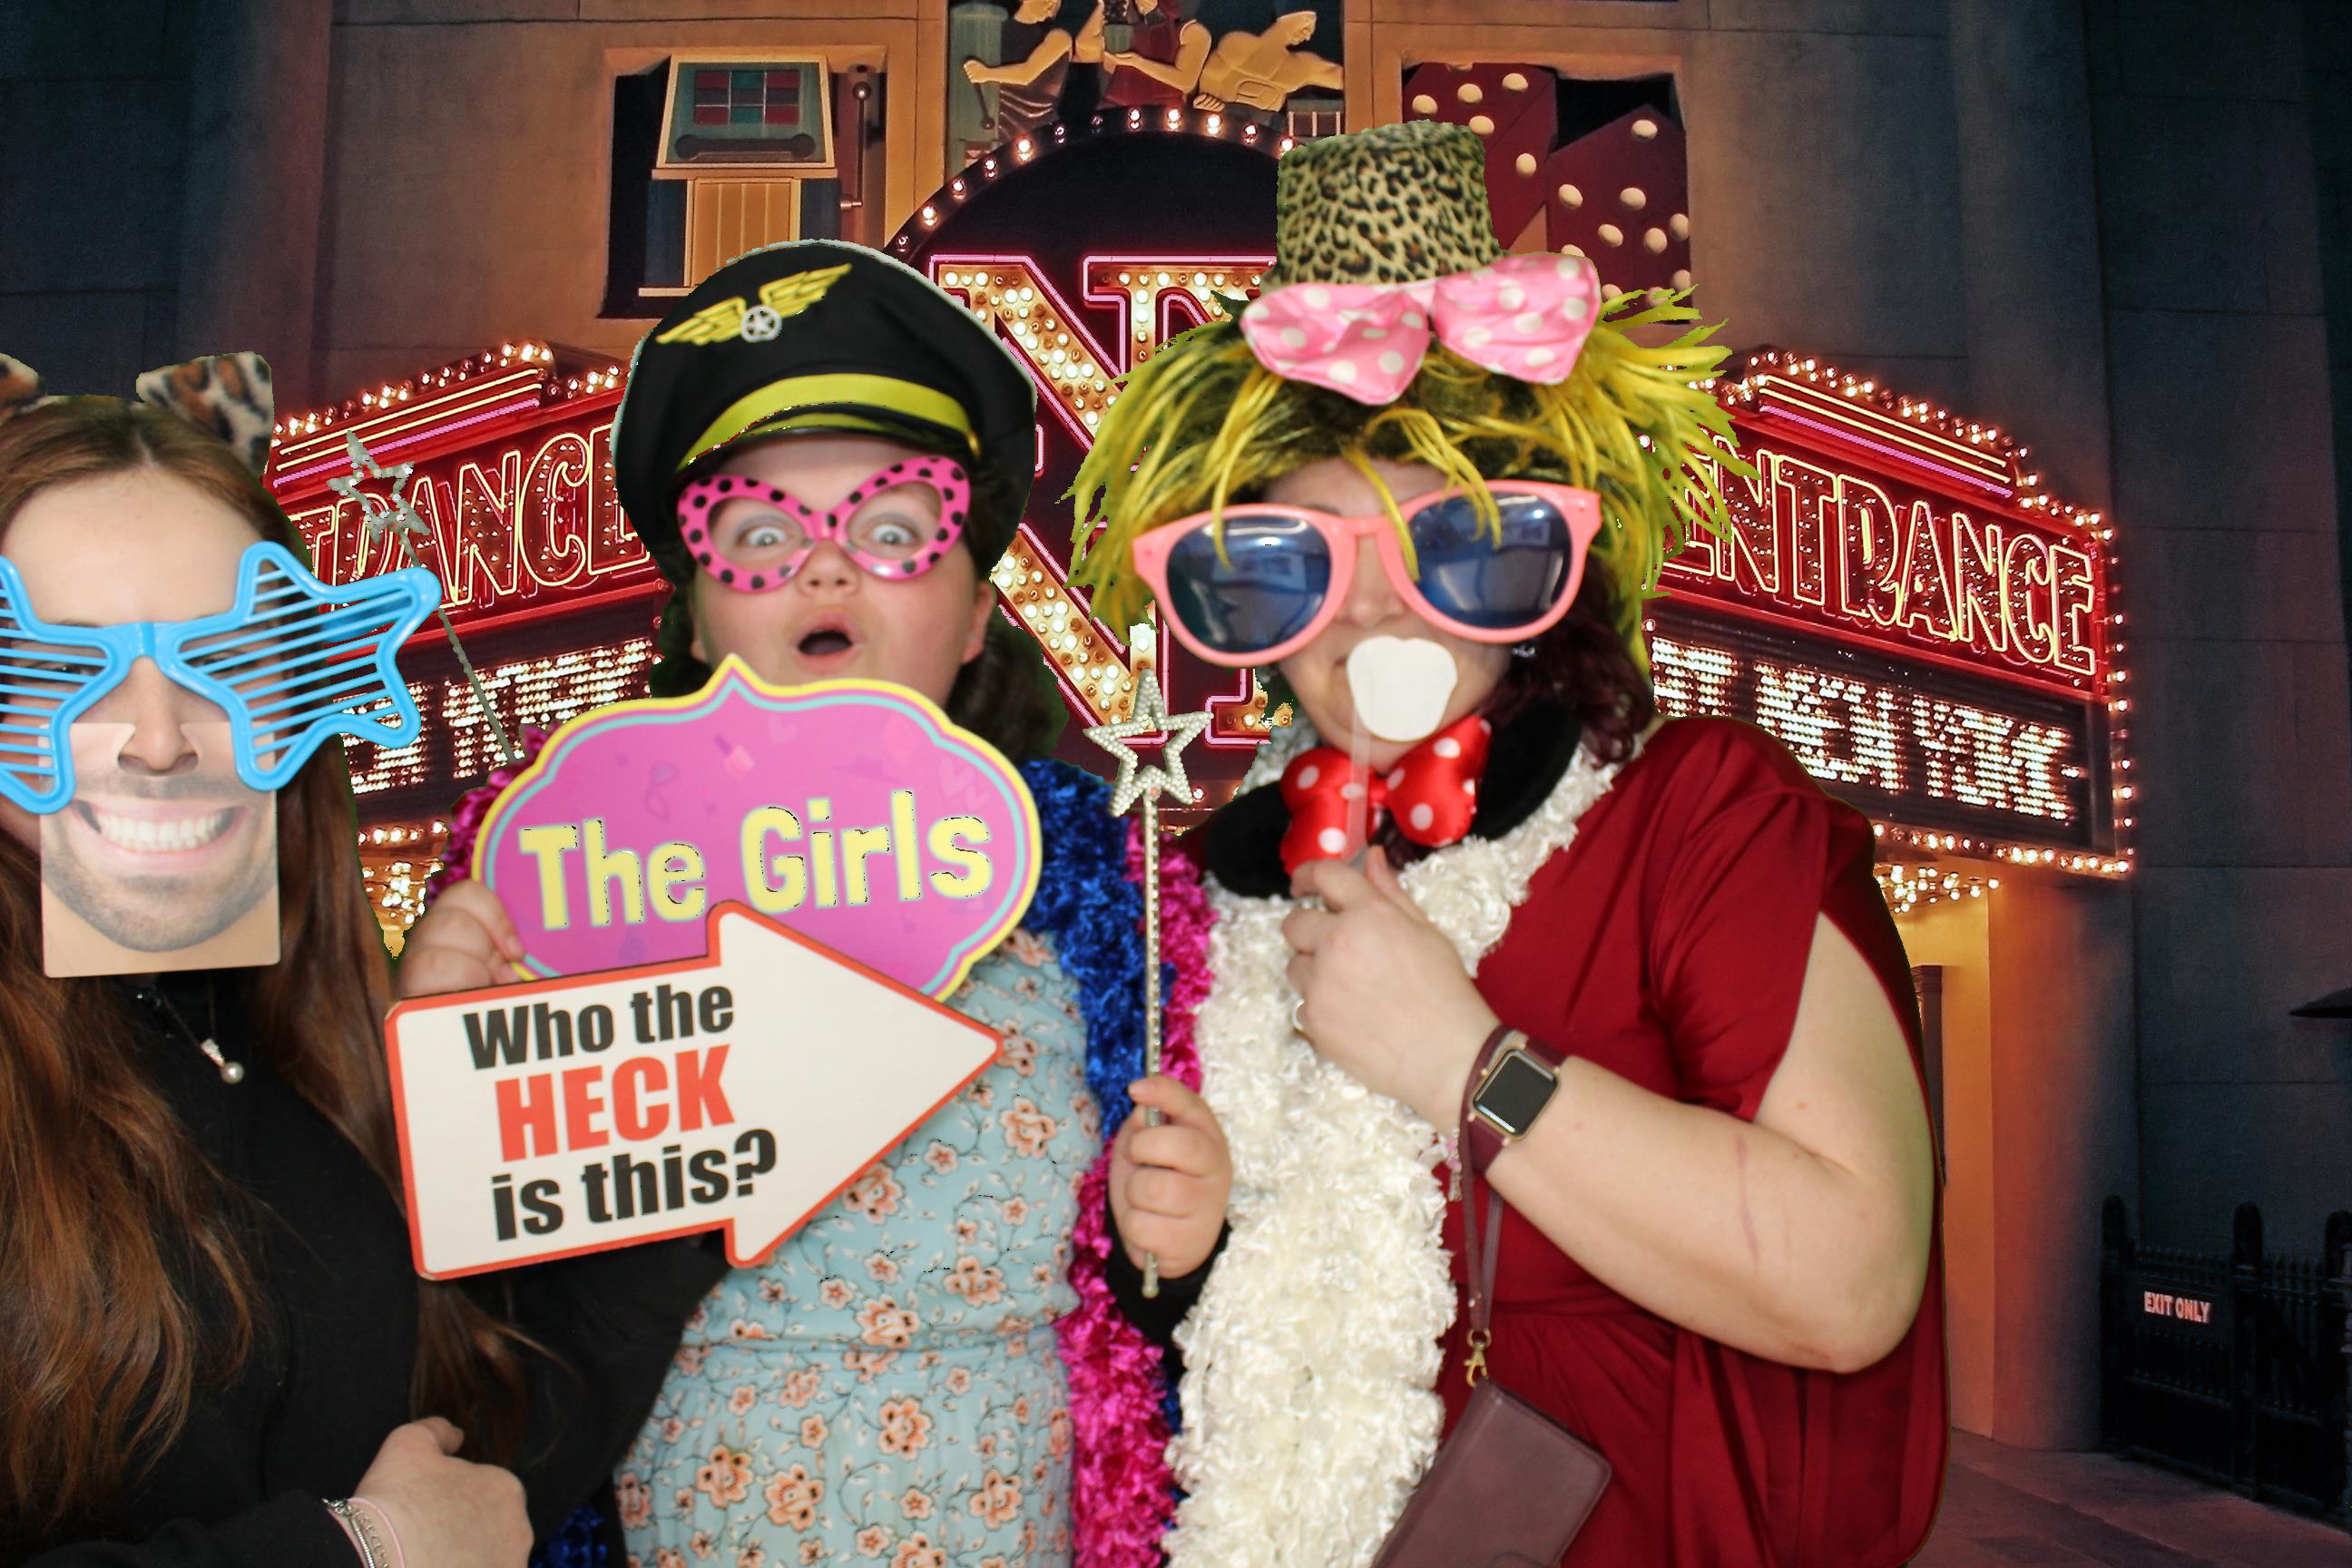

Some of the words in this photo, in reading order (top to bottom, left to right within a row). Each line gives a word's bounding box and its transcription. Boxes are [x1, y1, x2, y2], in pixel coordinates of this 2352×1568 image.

[517, 818, 707, 931] The
[740, 790, 993, 911] Girls
[463, 1003, 614, 1071] Who
[631, 984, 733, 1043] the
[495, 1044, 735, 1162] HECK
[491, 1173, 564, 1241] is
[582, 1128, 777, 1221] this?
[2144, 1291, 2173, 1316] EXIT
[2175, 1297, 2211, 1323] ONLY
